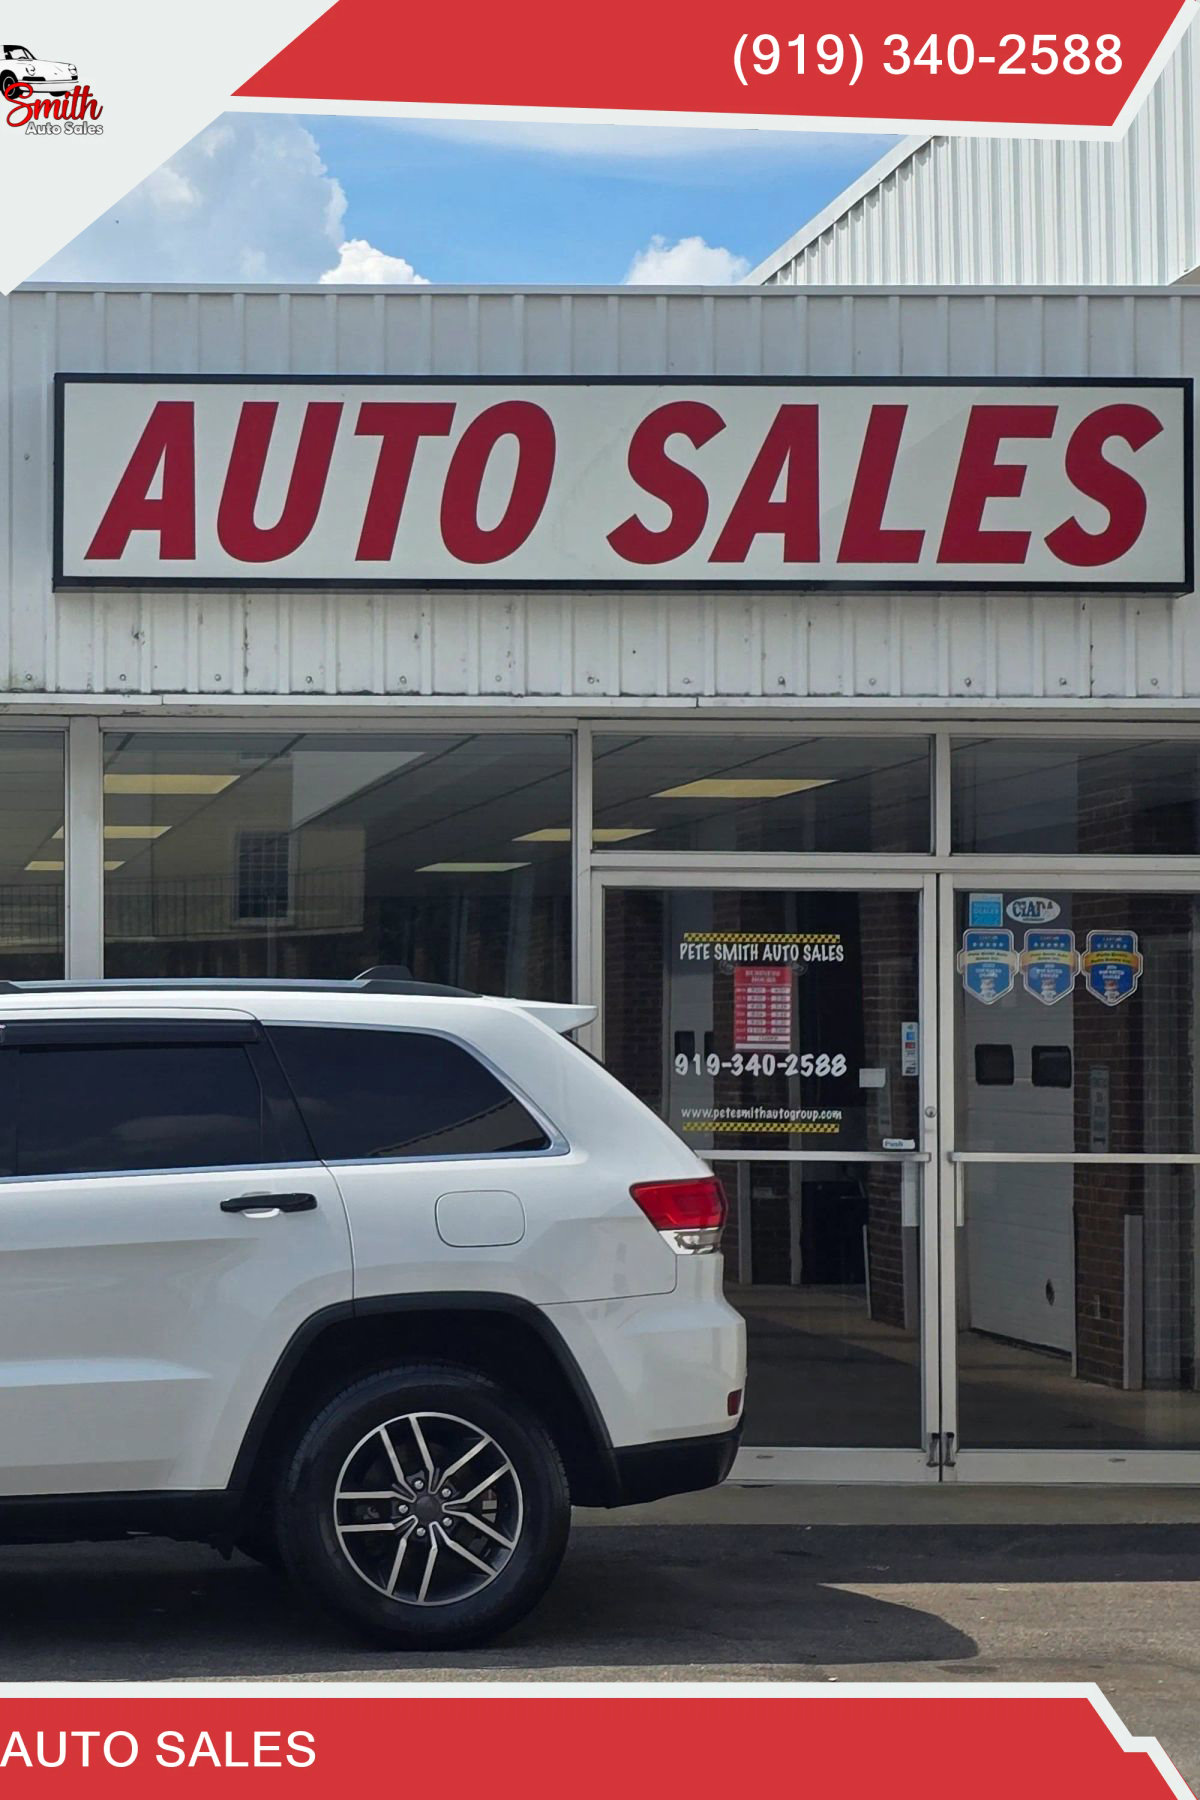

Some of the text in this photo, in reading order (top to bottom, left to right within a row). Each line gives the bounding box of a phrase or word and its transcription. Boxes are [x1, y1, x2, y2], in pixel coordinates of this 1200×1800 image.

[84, 399, 1164, 568] AUTO SALES
[679, 942, 845, 963] PETE SMITH AUTO SALES
[674, 1053, 848, 1078] 919-340-2588
[680, 1105, 843, 1122] www.petesmithautogroup.com
